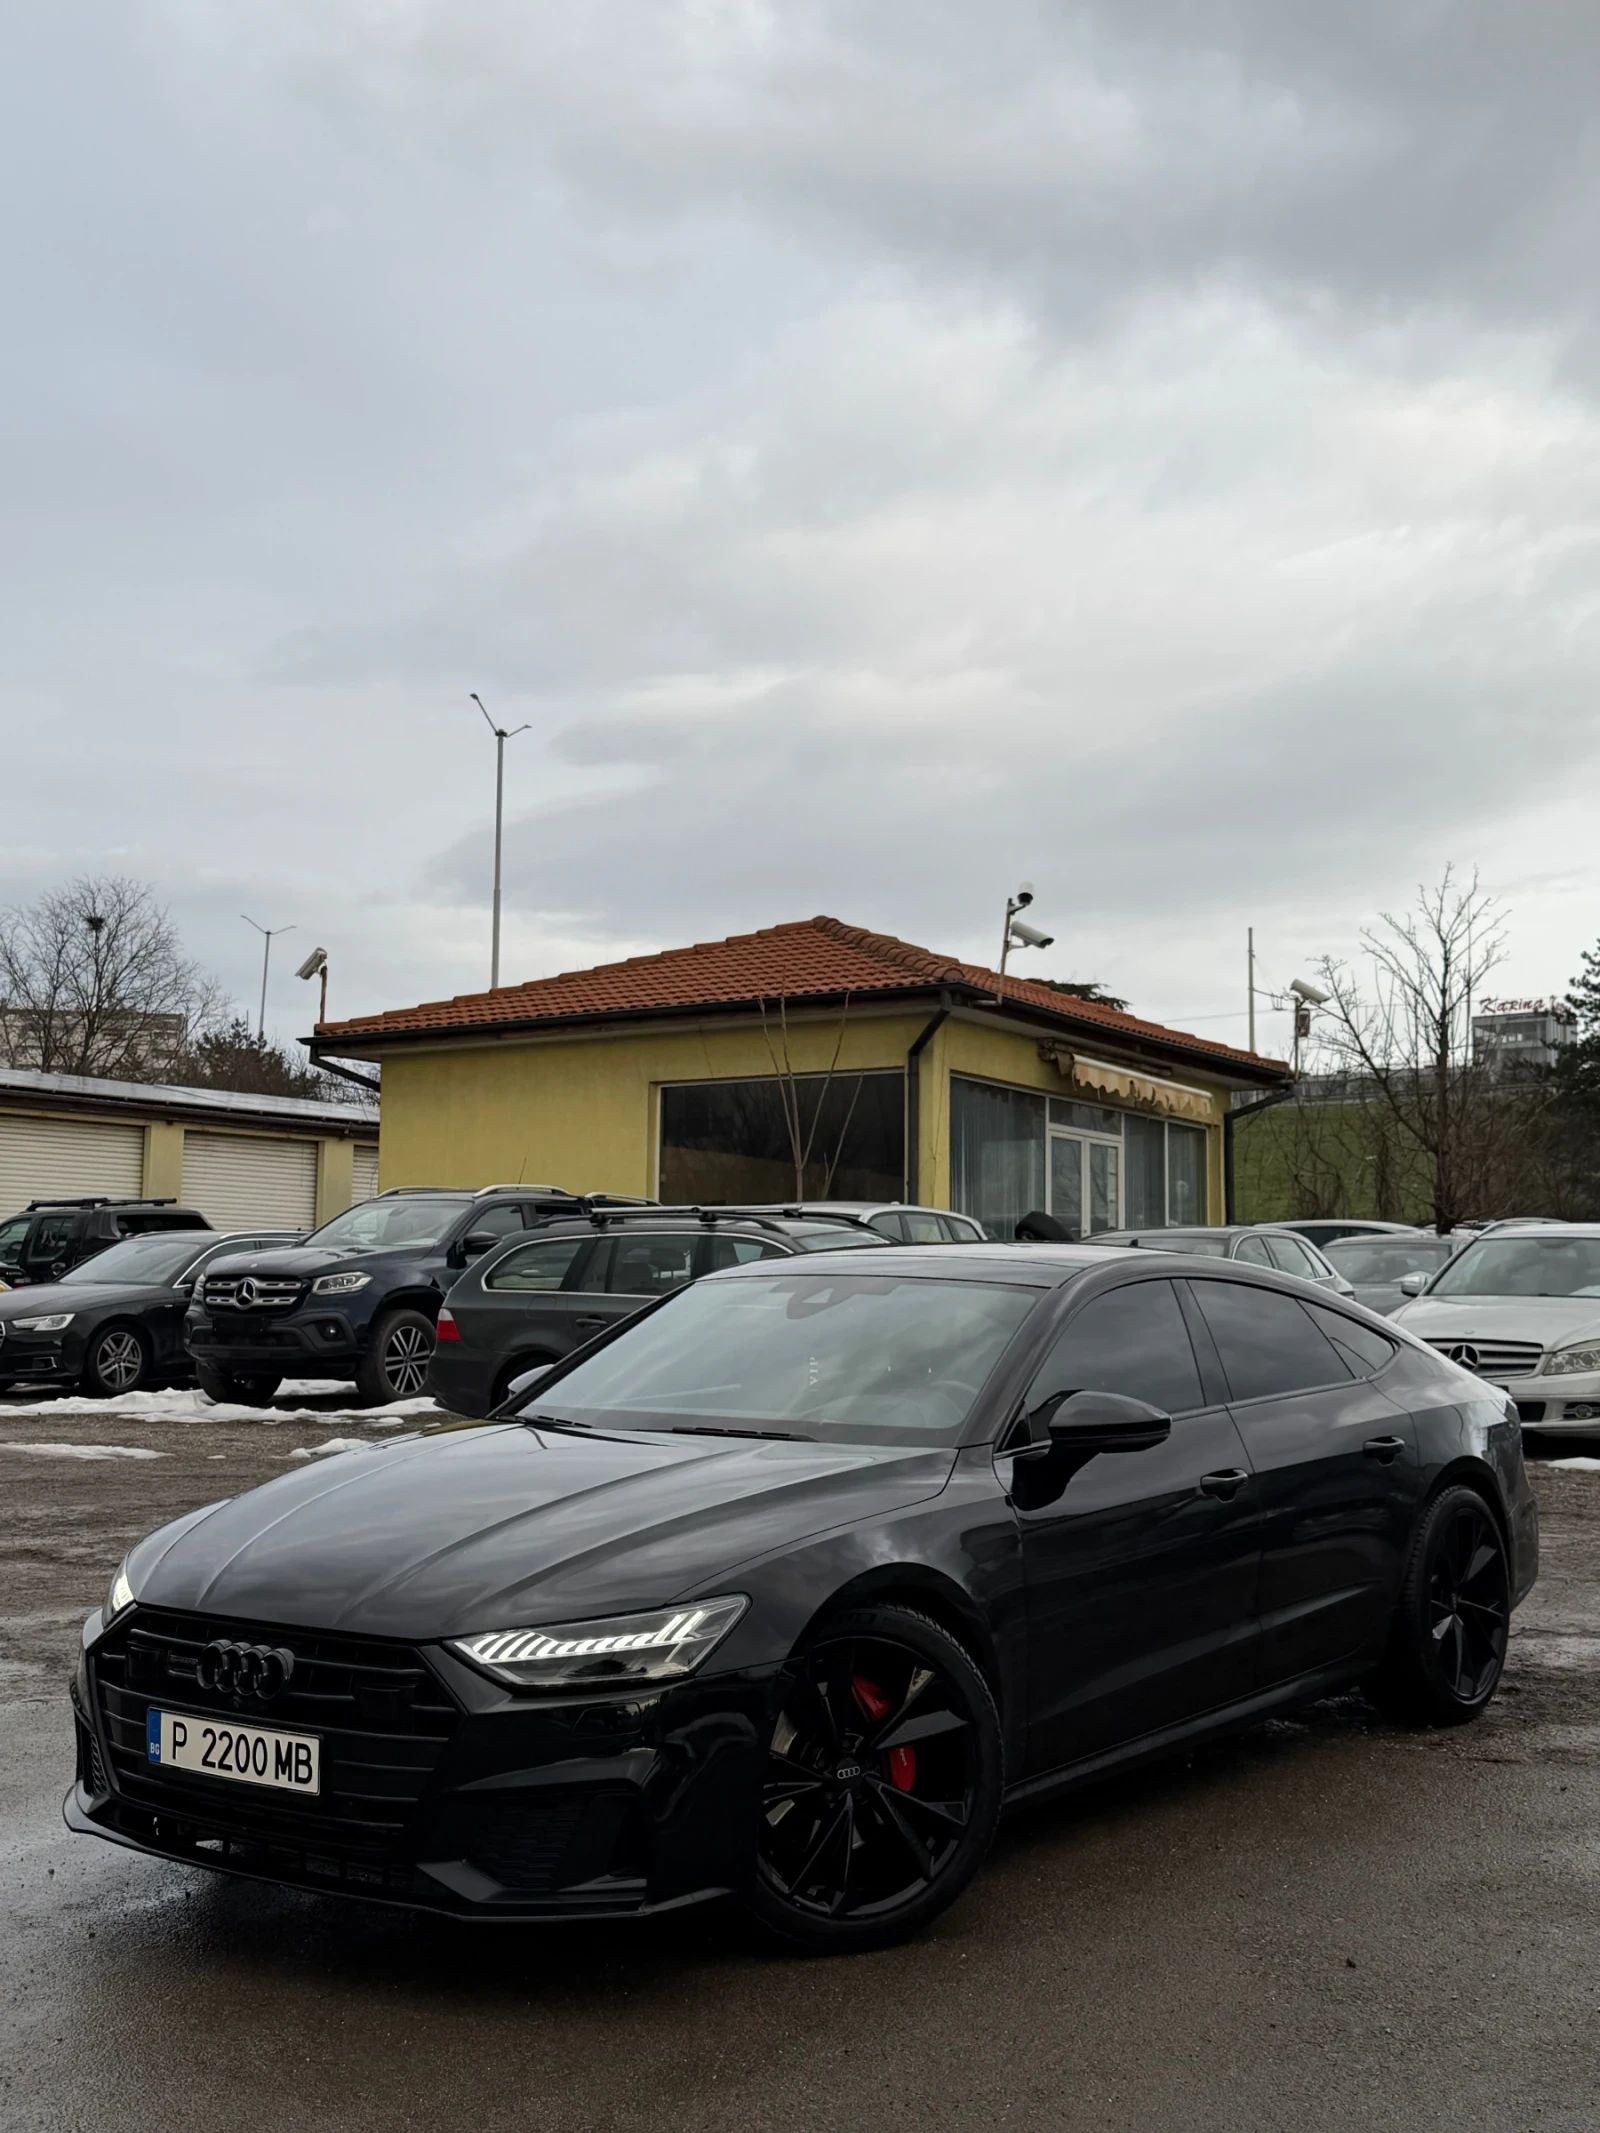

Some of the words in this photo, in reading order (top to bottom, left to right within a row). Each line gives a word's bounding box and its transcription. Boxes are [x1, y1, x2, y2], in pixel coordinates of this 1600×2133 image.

[809, 1356, 818, 1385] VIP
[150, 1742, 160, 1755] BG
[172, 1721, 187, 1760] P
[201, 1728, 268, 1777] 2200
[274, 1739, 313, 1785] MB
